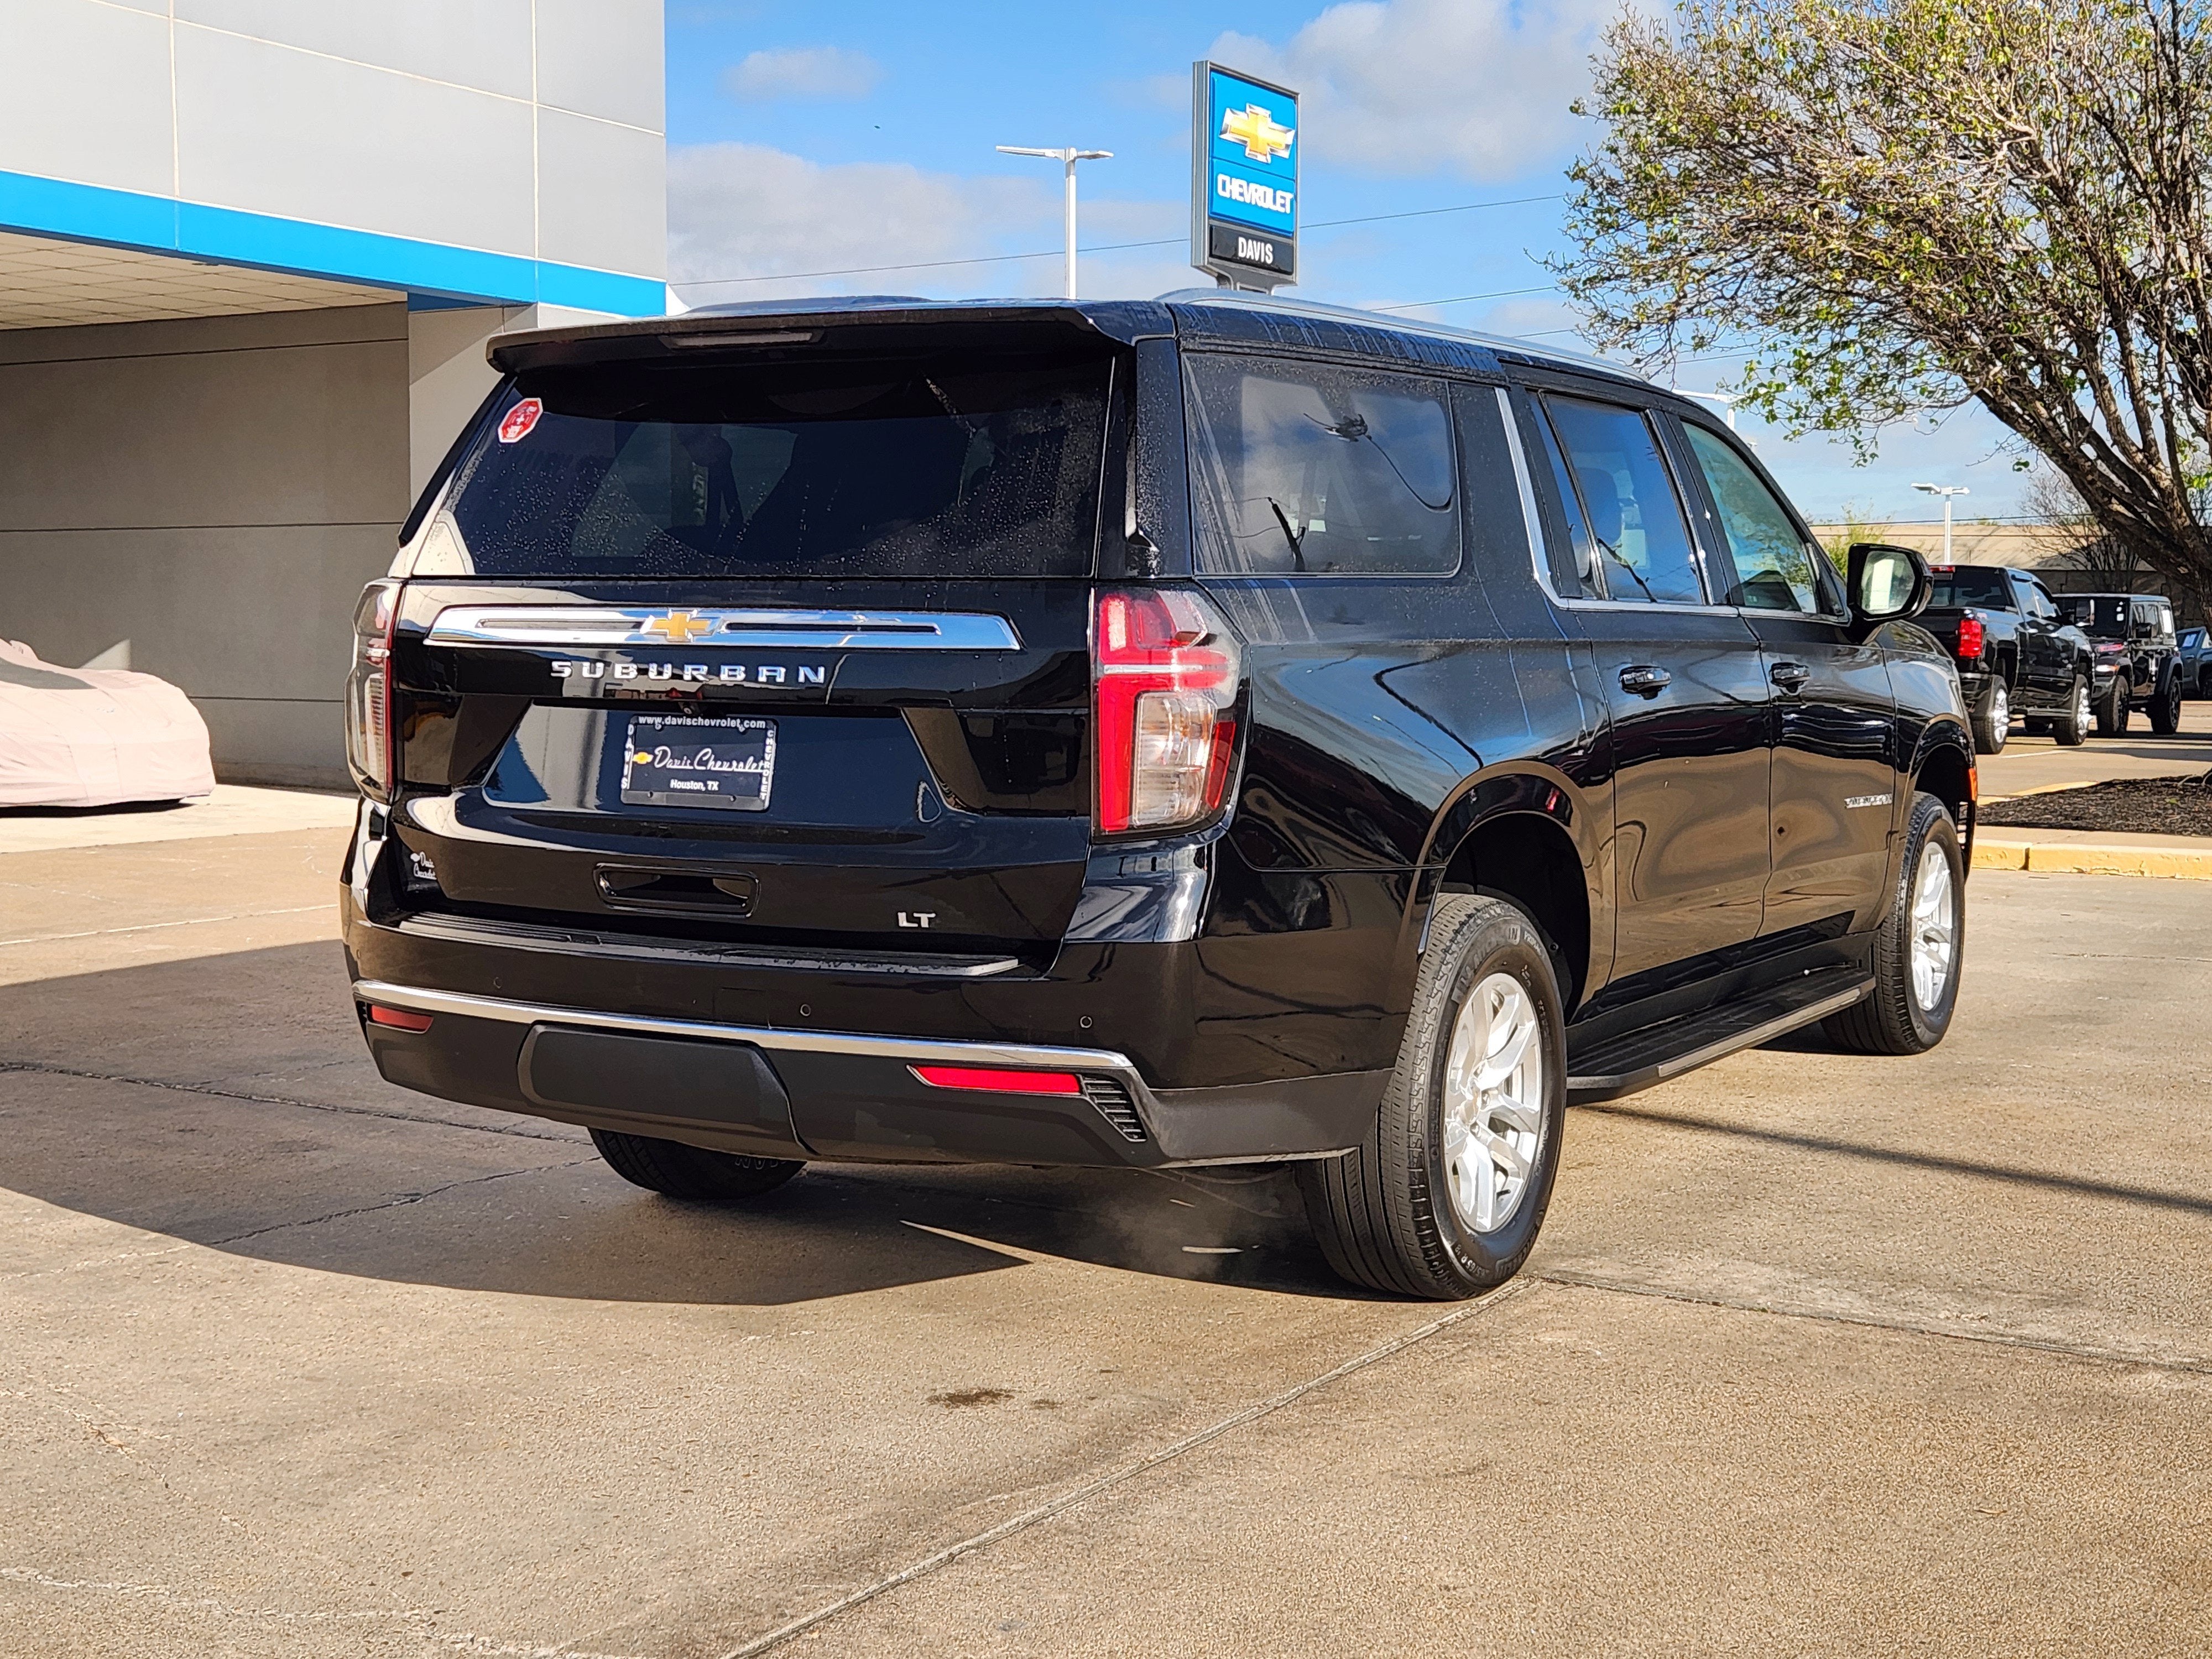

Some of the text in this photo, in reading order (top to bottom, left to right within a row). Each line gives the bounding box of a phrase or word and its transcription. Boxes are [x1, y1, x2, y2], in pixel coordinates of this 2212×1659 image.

[1217, 174, 1293, 213] CHEVROLET
[1238, 237, 1273, 264] DAVIS
[551, 661, 825, 683] SUBURBAN
[638, 716, 766, 729] www.davischevrolet.com
[621, 724, 634, 789] DAVIS
[654, 746, 764, 772] Davis Chevrolet
[759, 730, 774, 800] CHEVROLET
[707, 780, 719, 791] TX
[898, 912, 936, 928] LT
